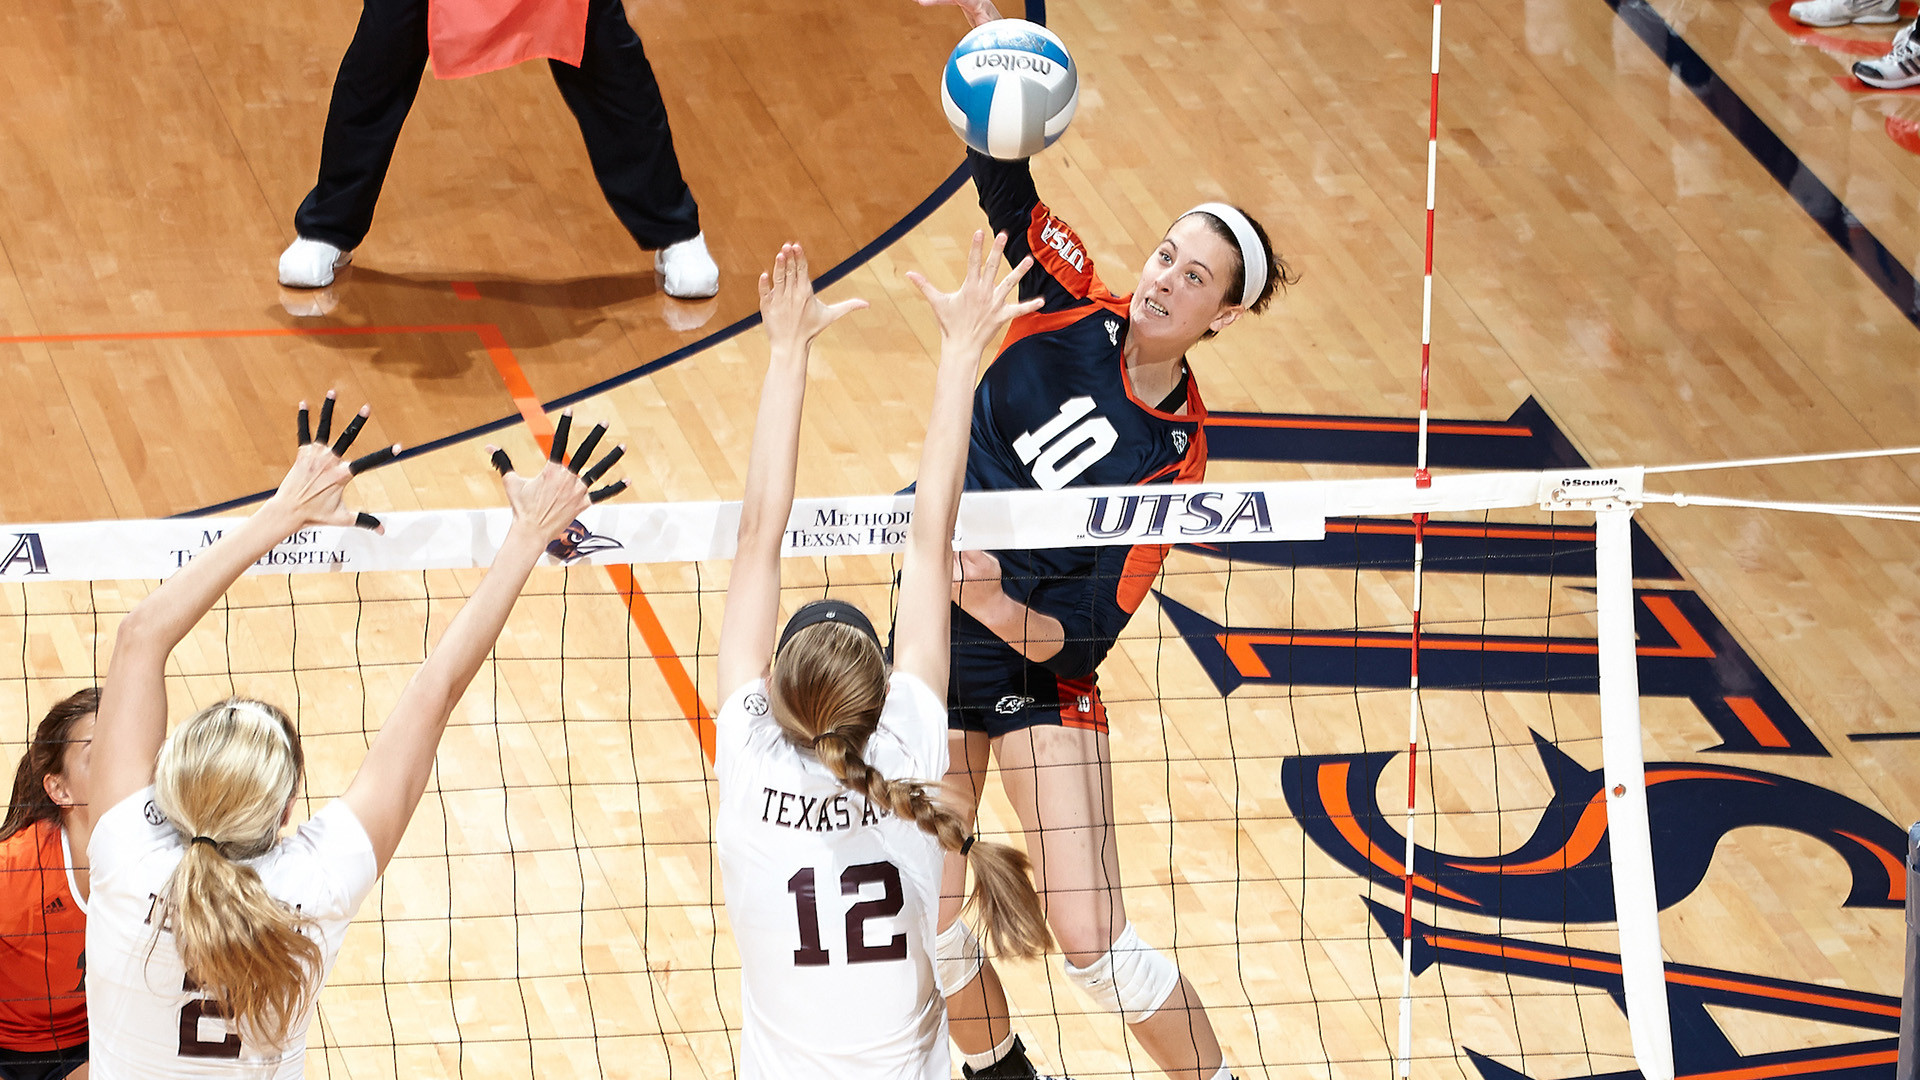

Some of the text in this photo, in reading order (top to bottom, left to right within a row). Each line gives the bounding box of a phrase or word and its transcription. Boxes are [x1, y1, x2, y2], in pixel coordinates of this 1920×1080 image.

[976, 53, 1051, 75] molten
[1041, 217, 1084, 273] UTSA
[1012, 396, 1119, 490] 10
[1572, 478, 1618, 487] Senoh
[813, 507, 914, 528] METHODI
[1086, 490, 1275, 539] UTSA
[785, 529, 861, 548] TEXSAN
[1077, 695, 1091, 713] 10
[762, 786, 850, 832] TEXAS
[787, 860, 908, 967] 12
